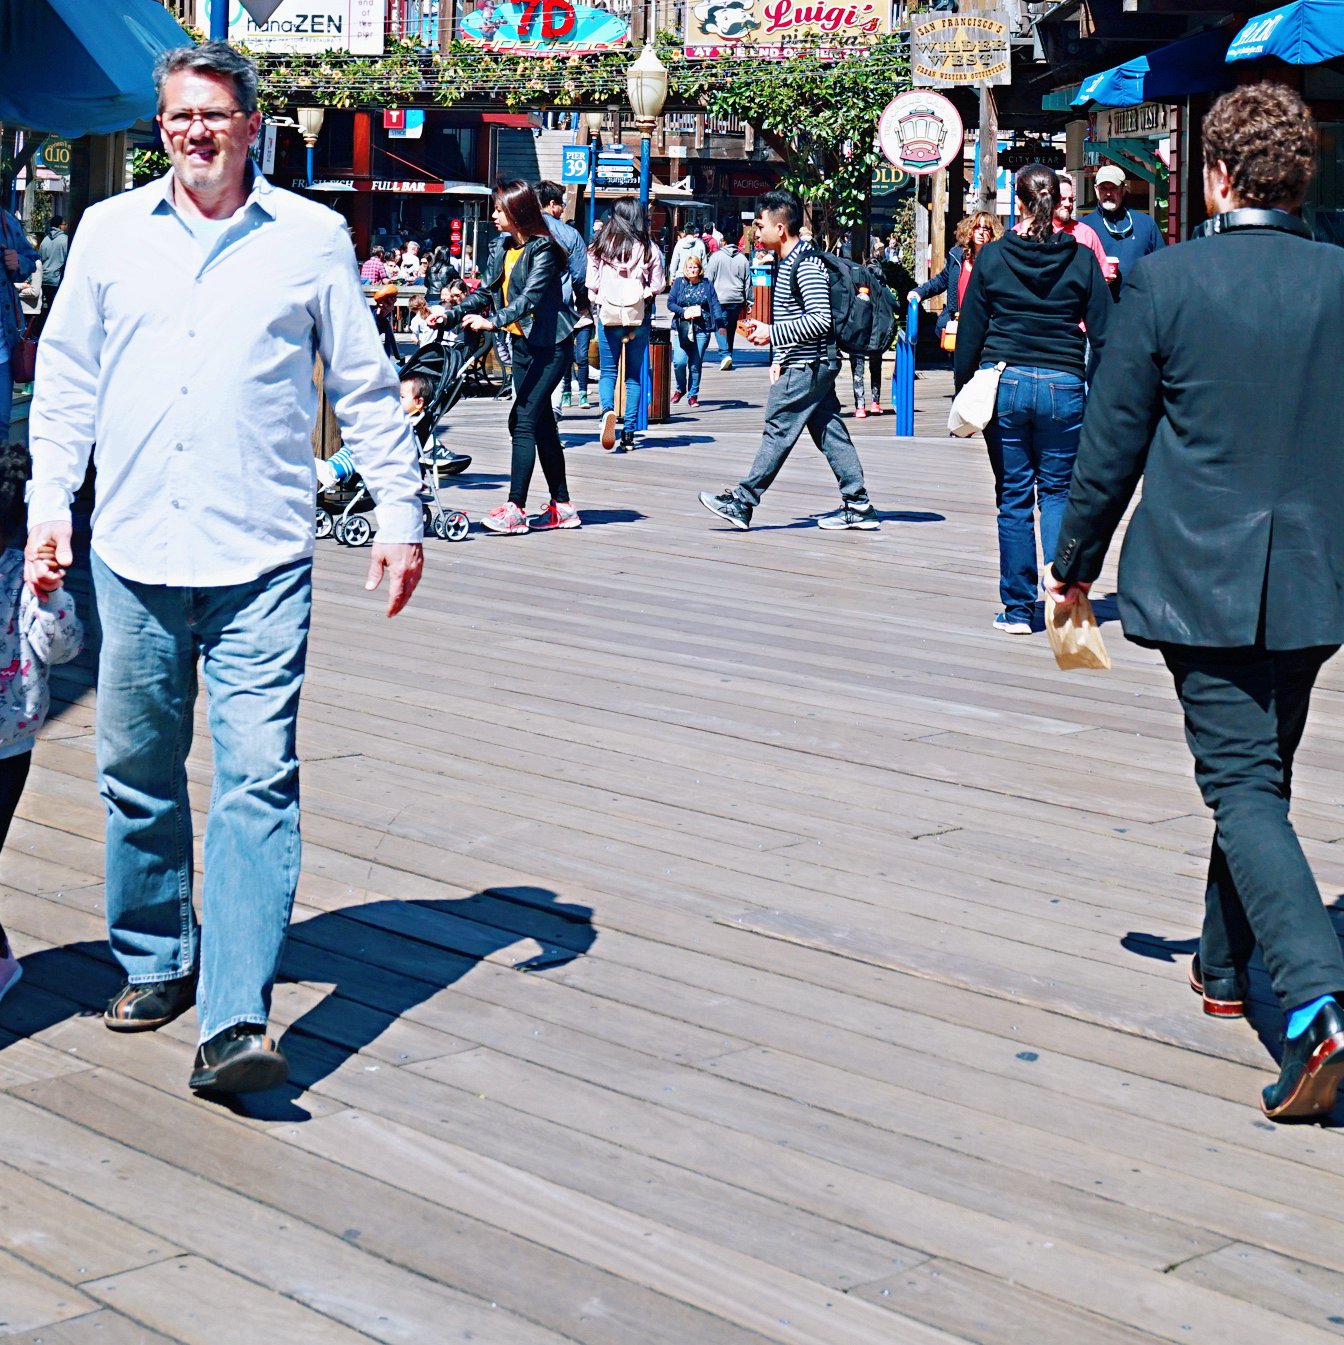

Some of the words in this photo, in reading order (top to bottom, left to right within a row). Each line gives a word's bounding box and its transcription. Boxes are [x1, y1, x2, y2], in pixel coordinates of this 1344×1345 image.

[917, 22, 936, 36] SAN
[942, 17, 1003, 34] FRANCISCO'S
[916, 39, 1007, 53] WILDER
[928, 54, 993, 67] WEST
[916, 64, 937, 77] URBAN
[940, 72, 968, 81] WESTERN
[971, 62, 1007, 79] OUTFITTERS
[566, 151, 586, 161] PIER
[1008, 156, 1030, 164] CITY
[565, 160, 587, 177] 39
[371, 181, 402, 191] FULL
[402, 181, 426, 193] BAR
[733, 179, 759, 189] PACIFIC
